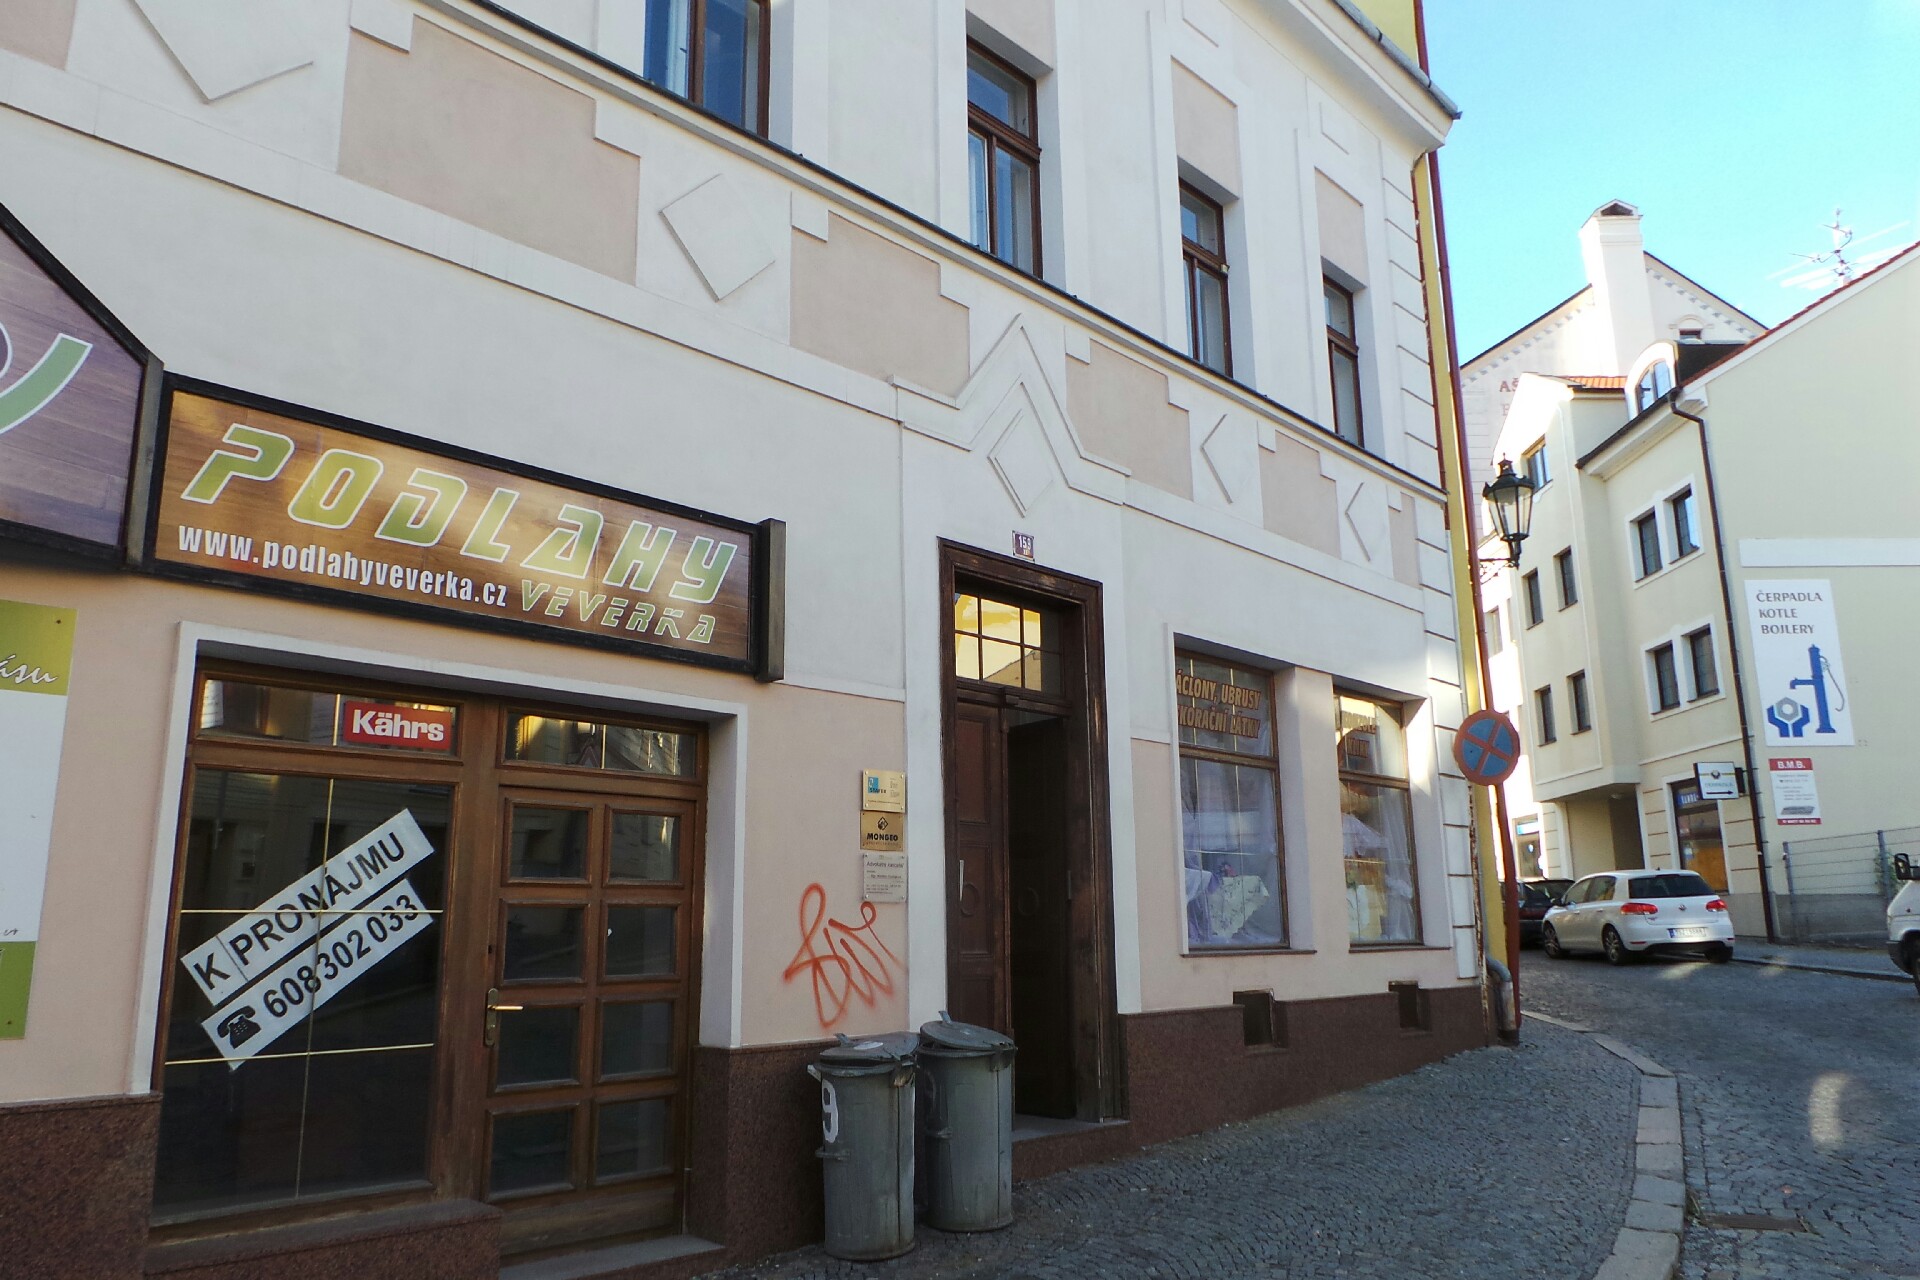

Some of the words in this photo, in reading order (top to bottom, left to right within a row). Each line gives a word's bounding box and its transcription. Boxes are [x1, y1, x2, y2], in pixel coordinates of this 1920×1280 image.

[180, 422, 738, 604] PODLAHY
[178, 525, 507, 608] www.podlahyveverka.cz
[1756, 589, 1823, 602] ČERPADLA
[521, 579, 716, 643] VEVERKA
[1759, 608, 1798, 618] KOTLE
[1761, 624, 1814, 634] BOJLERY
[1221, 683, 1261, 710] UBRUSY
[352, 709, 444, 741] Kährs
[1777, 760, 1806, 769] B.M.B.
[193, 953, 230, 990] K
[229, 832, 405, 966] PRONÁJMU
